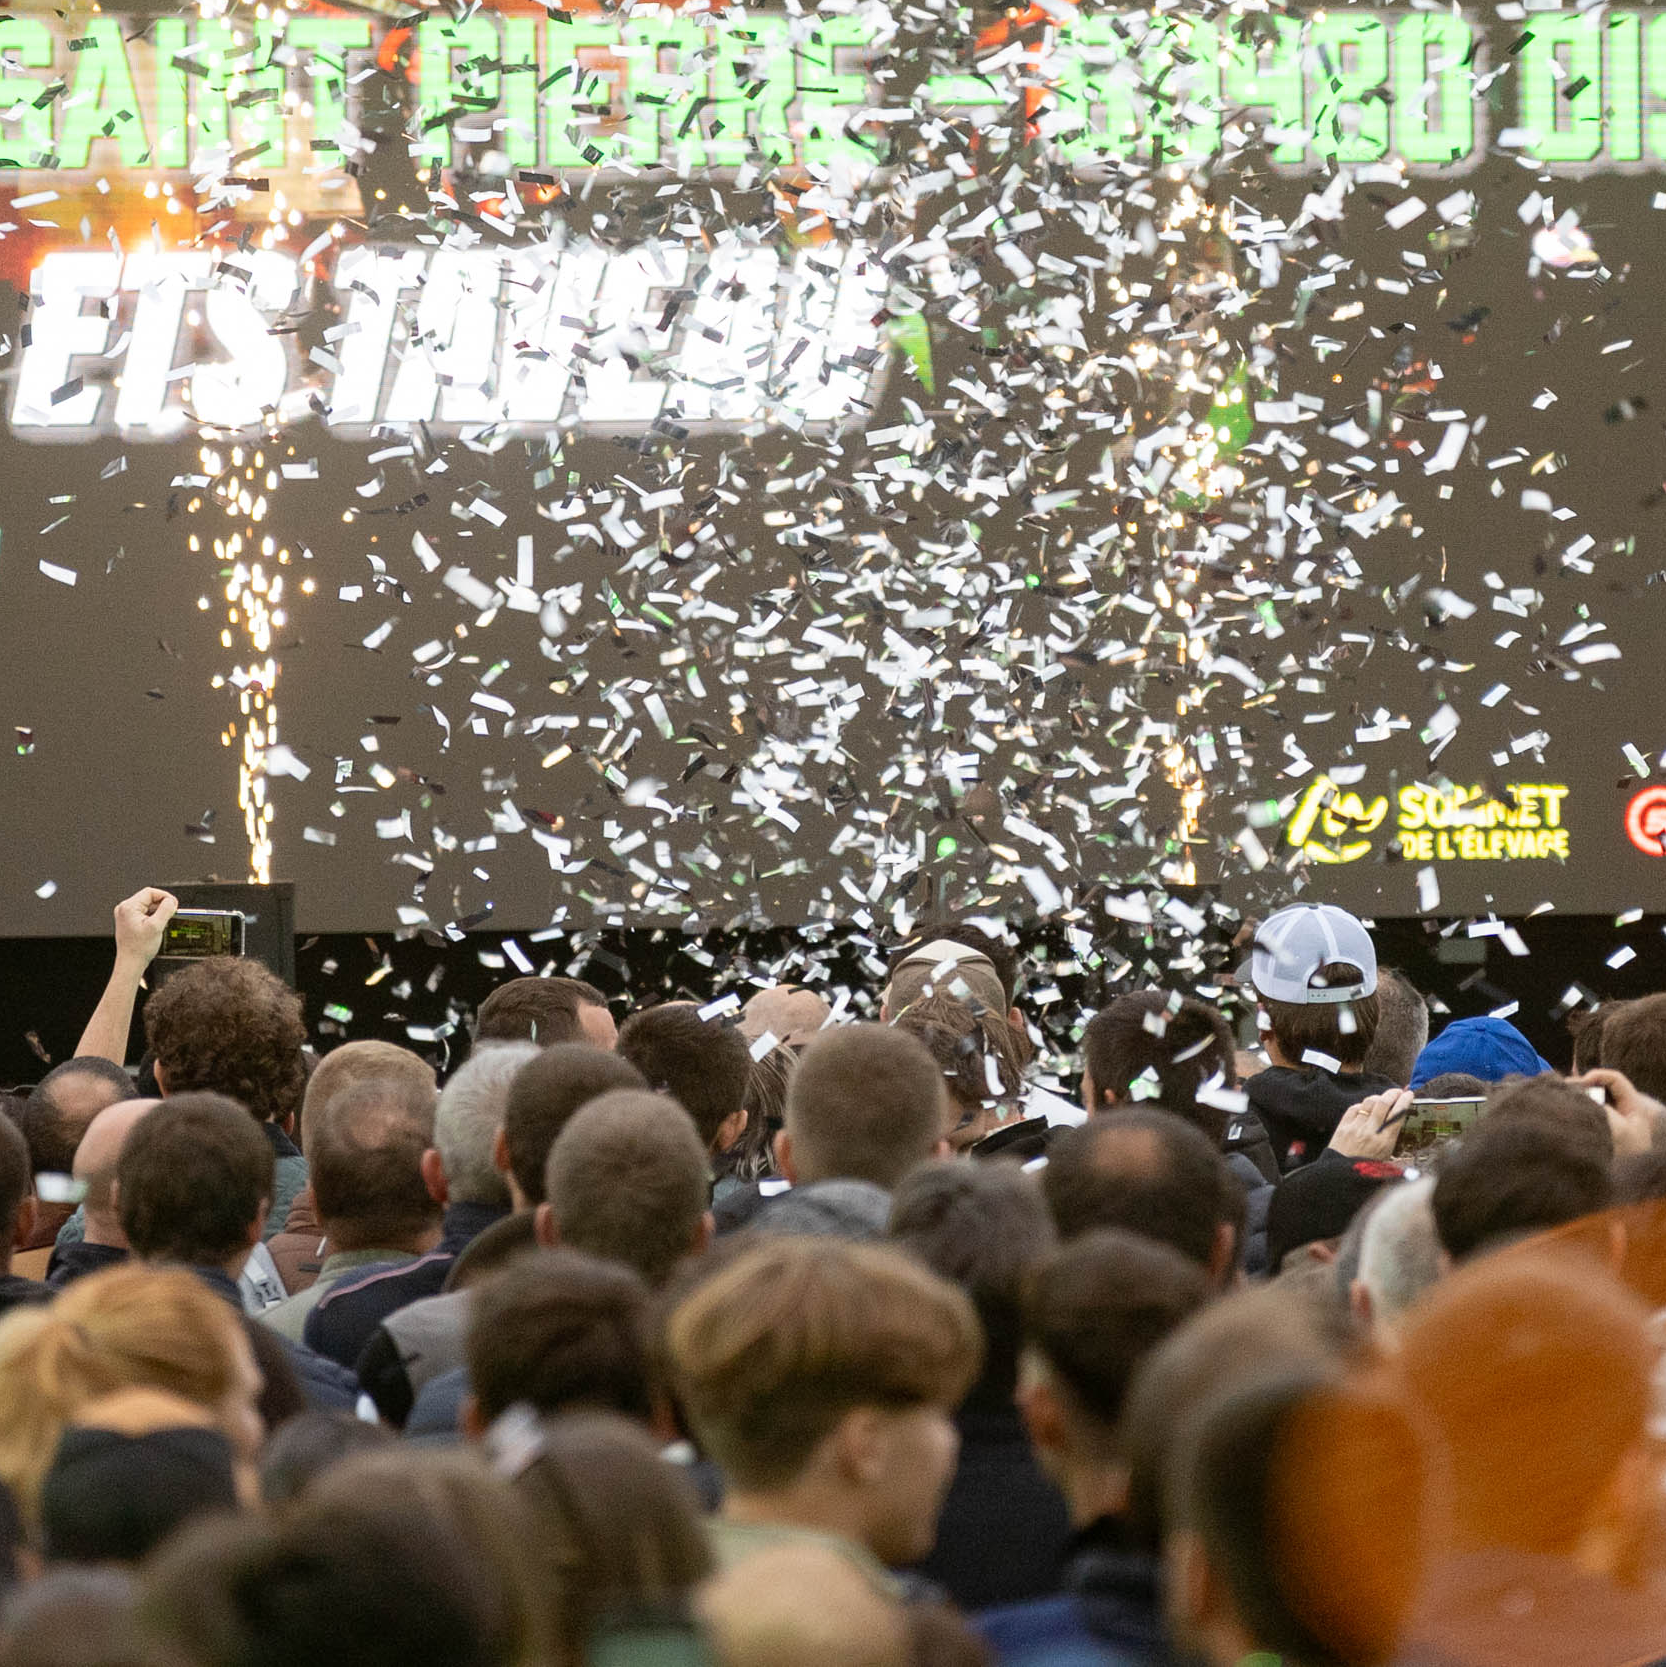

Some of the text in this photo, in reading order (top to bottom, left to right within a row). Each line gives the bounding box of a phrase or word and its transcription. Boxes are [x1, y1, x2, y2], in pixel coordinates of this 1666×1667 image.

[417, 15, 878, 168] PIERRE
[10, 248, 301, 427] ETS
[1398, 829, 1434, 861] DE
